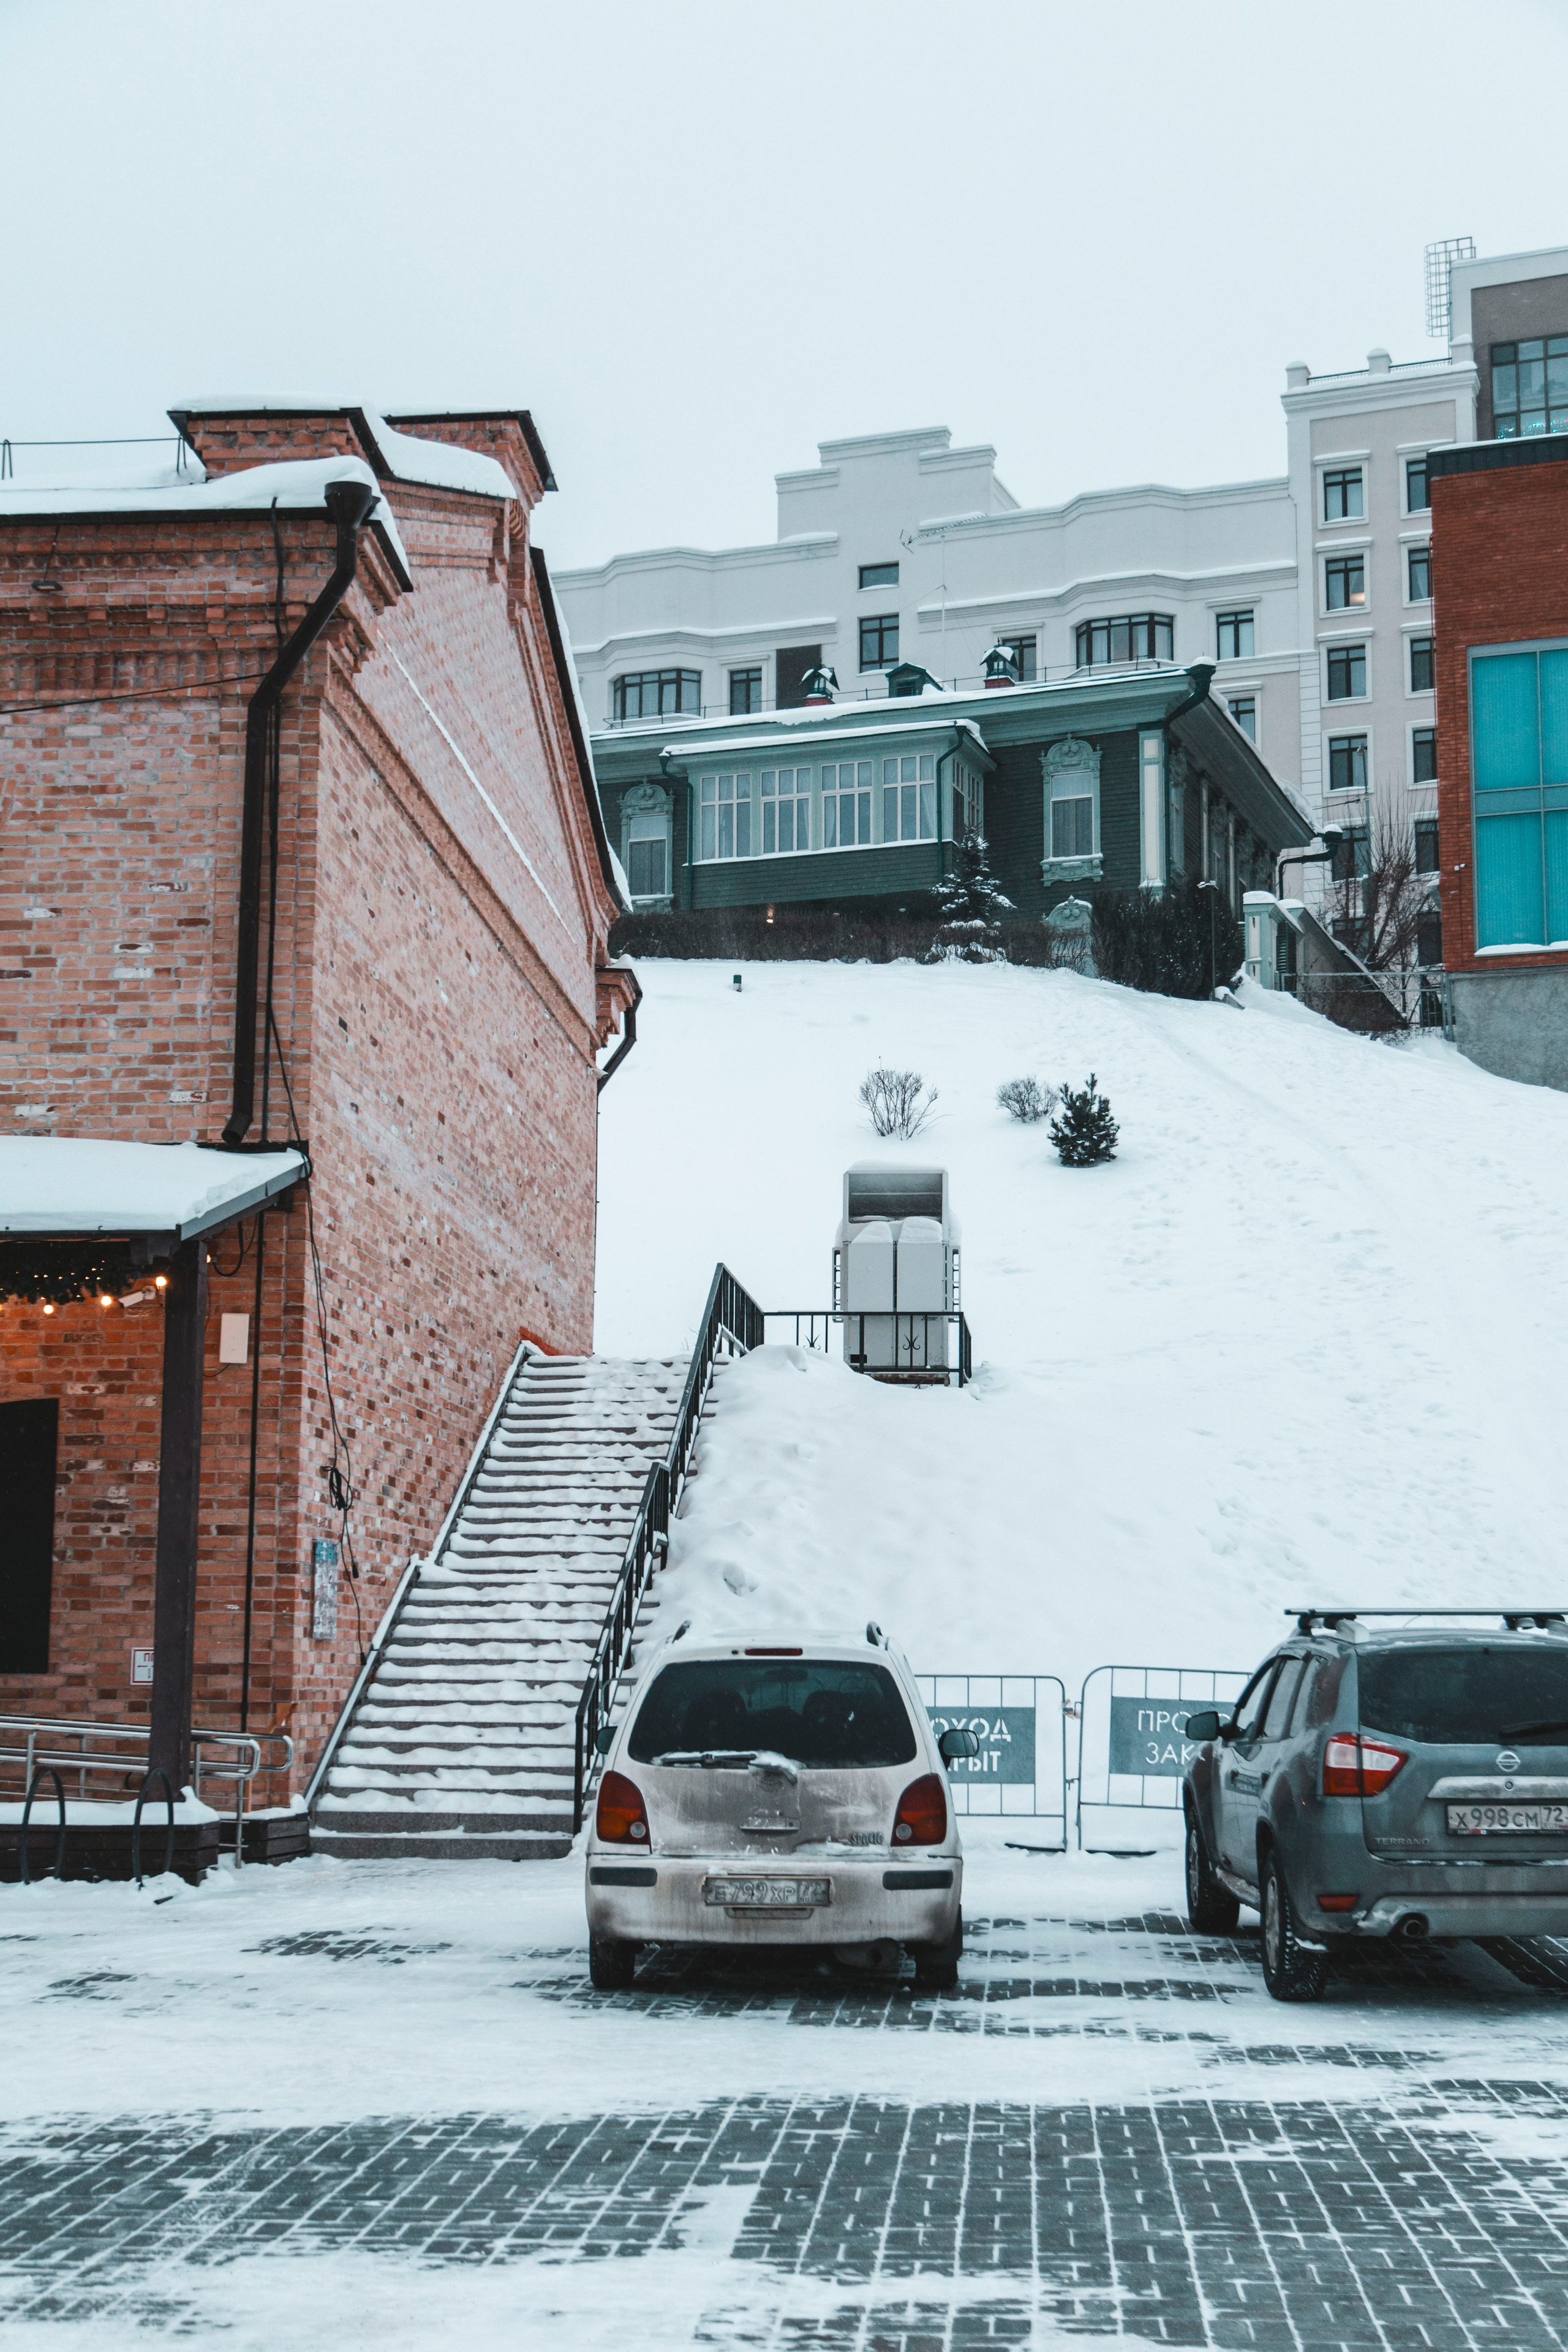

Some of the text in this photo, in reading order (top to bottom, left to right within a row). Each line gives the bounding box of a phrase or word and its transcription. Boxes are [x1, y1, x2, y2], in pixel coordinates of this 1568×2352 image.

[930, 1717, 1011, 1742] ОХОД
[1138, 1710, 1231, 1734] ПРО
[948, 1751, 1001, 1772] РЫТ
[1145, 1742, 1194, 1765] ЗАК
[1543, 1807, 1563, 1822] 72
